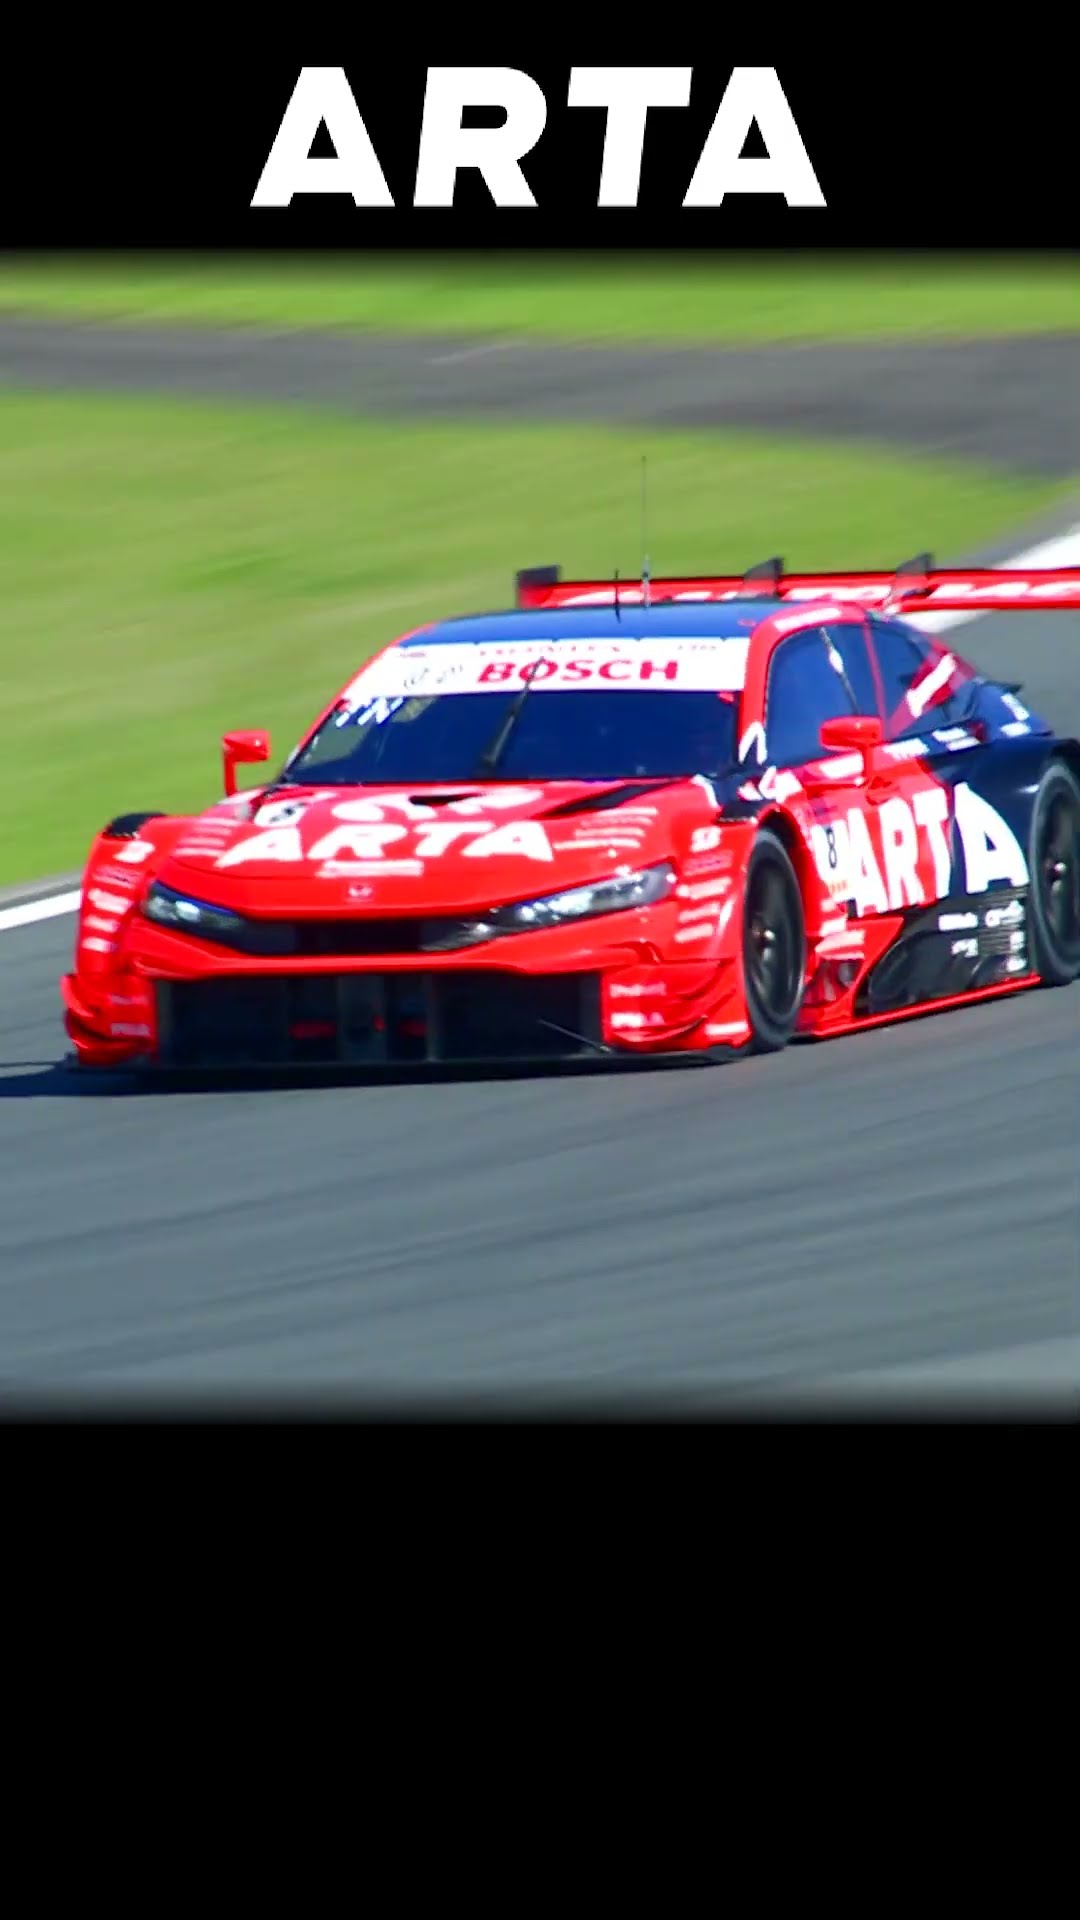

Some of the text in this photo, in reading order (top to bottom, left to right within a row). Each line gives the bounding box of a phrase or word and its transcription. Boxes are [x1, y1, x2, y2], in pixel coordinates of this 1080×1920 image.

[477, 659, 680, 684] BOSCH
[213, 821, 554, 868] ARTA
[826, 827, 838, 869] 8
[847, 782, 1030, 918] ARTA
